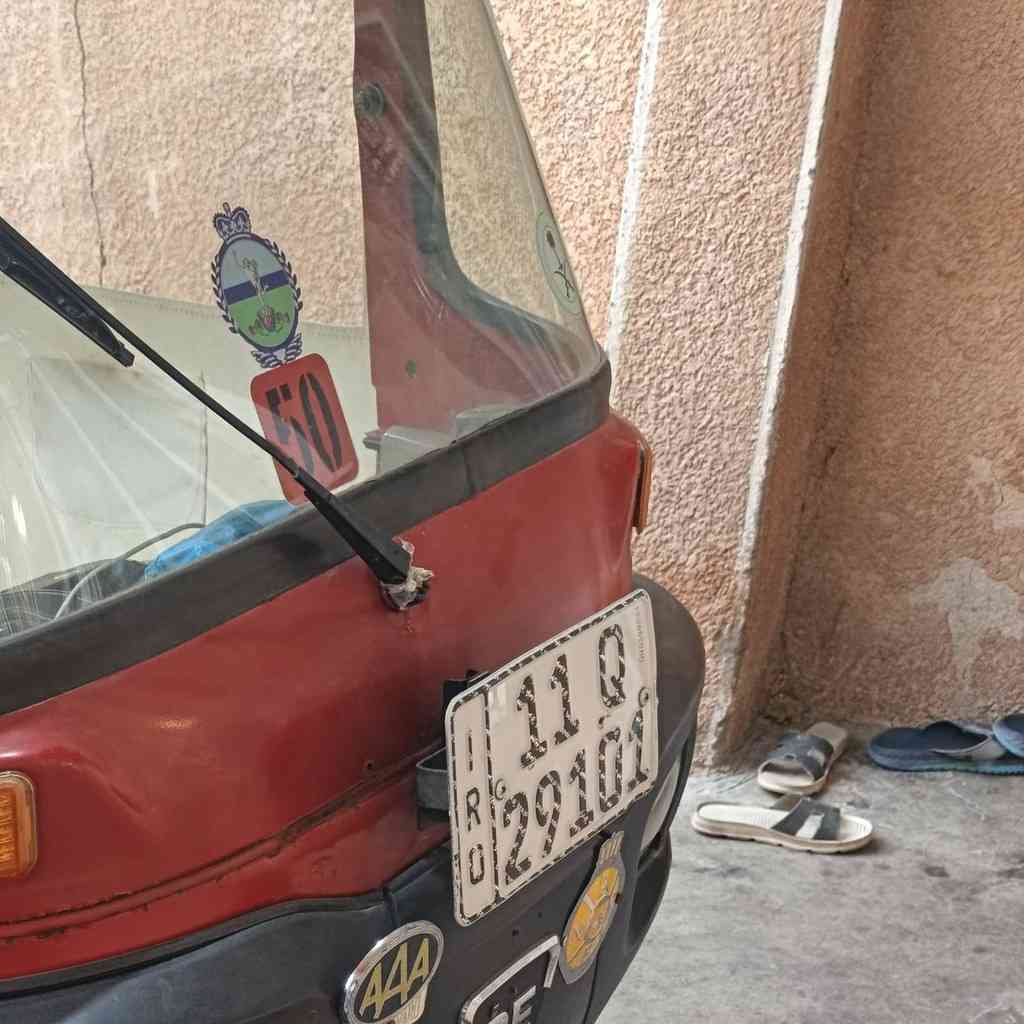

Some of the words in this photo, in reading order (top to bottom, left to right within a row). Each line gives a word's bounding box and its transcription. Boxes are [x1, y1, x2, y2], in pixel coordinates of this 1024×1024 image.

[516, 653, 580, 769] 11
[597, 623, 626, 709] Q
[502, 709, 649, 886] 29101
[359, 938, 429, 1019] AAA
